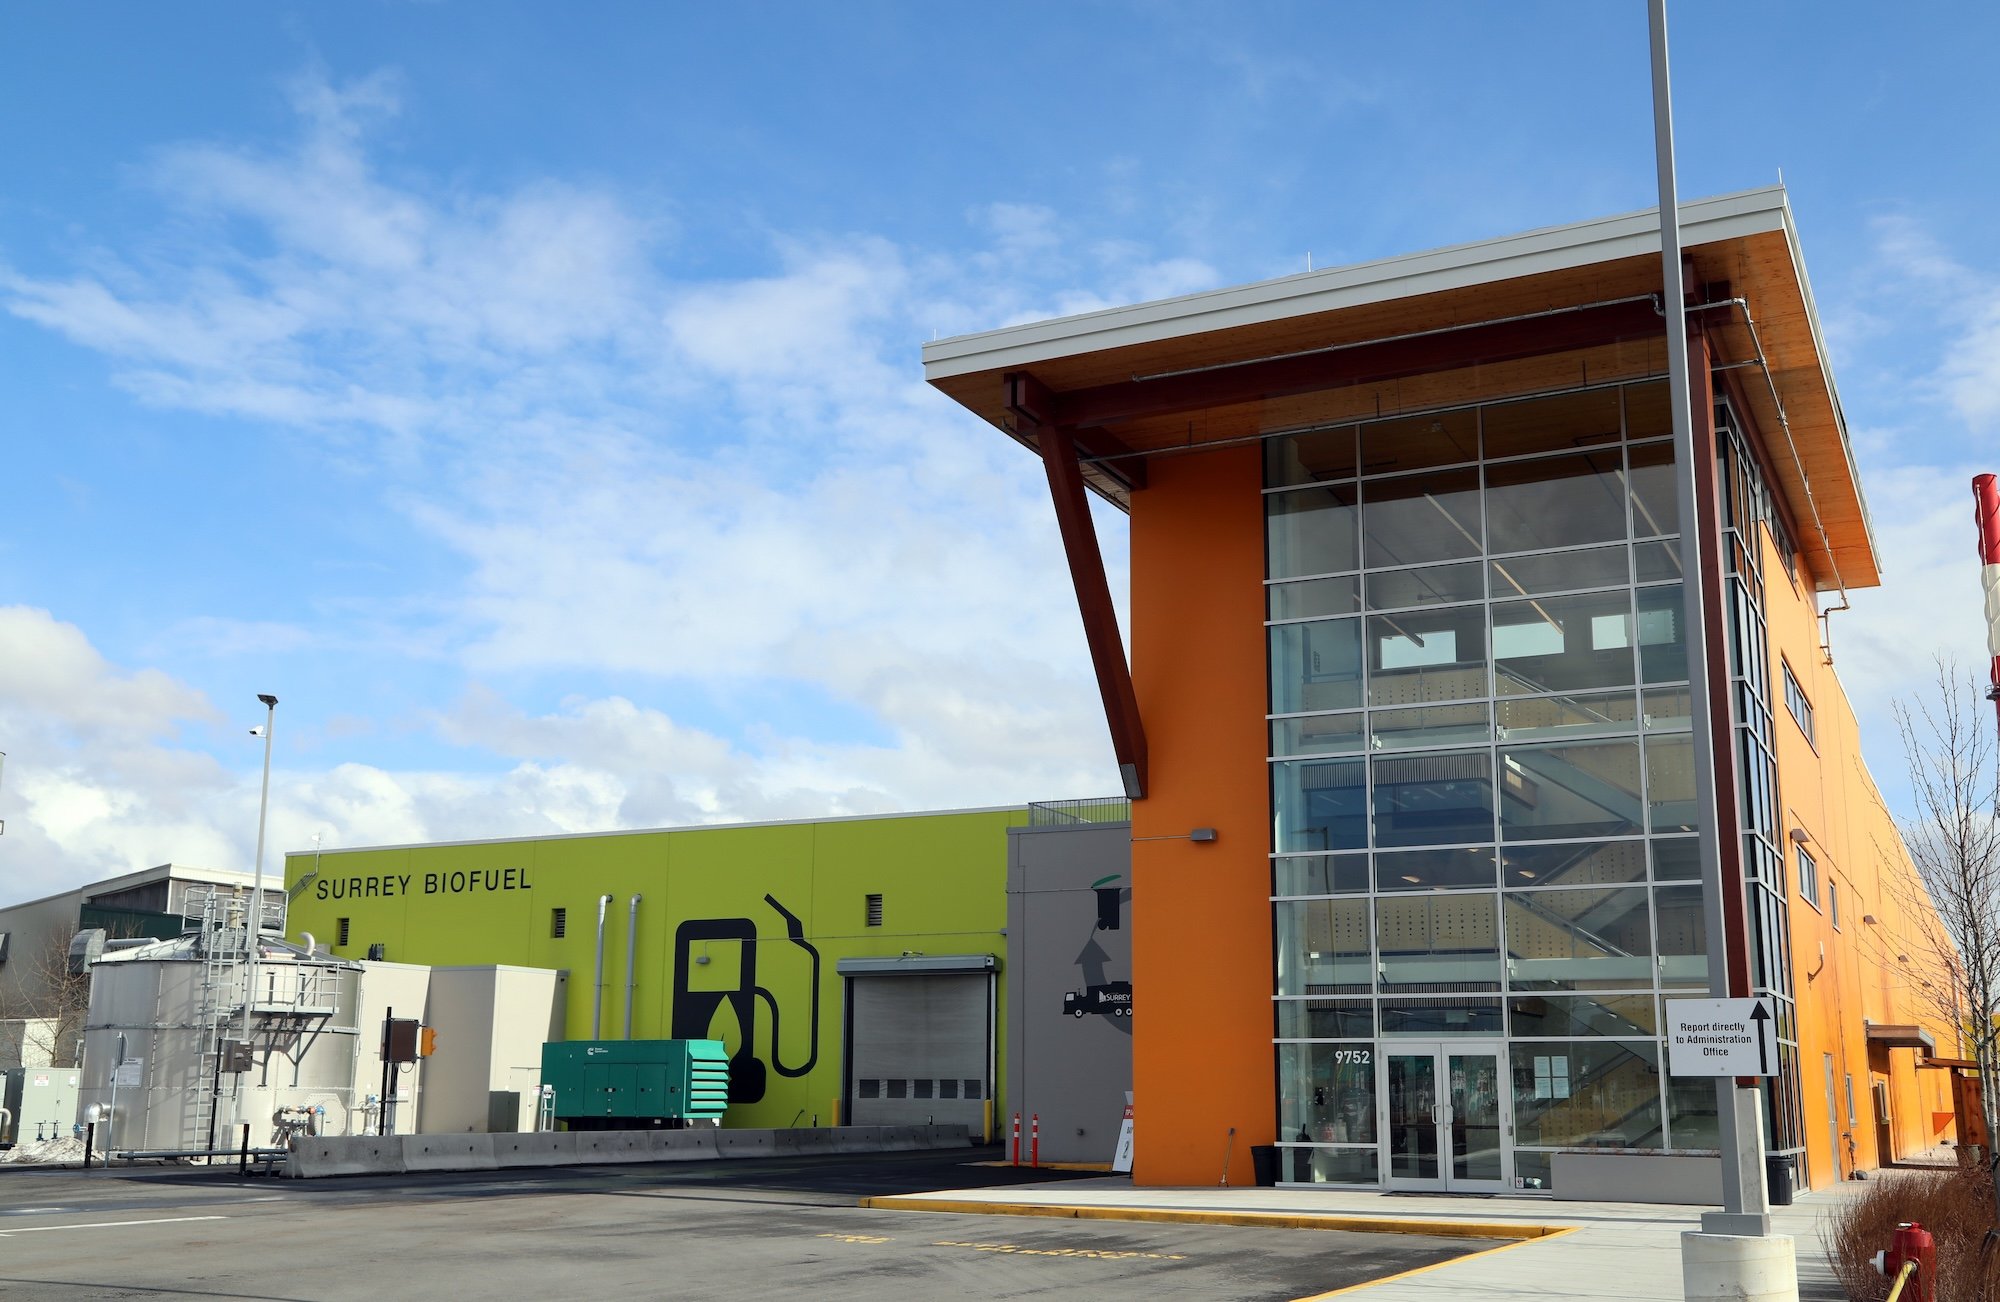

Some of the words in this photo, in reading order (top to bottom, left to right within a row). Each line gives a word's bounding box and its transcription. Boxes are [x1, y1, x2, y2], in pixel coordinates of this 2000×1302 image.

[316, 874, 412, 900] SURREY
[424, 868, 532, 894] BIOFUEL
[1106, 993, 1131, 1001] SURREY
[1680, 1022, 1709, 1033] Report
[1712, 1022, 1745, 1033] directly
[1675, 1035, 1685, 1044] to
[1687, 1035, 1752, 1044] Administration
[1703, 1047, 1729, 1056] Office
[1334, 1050, 1370, 1064] 9752
